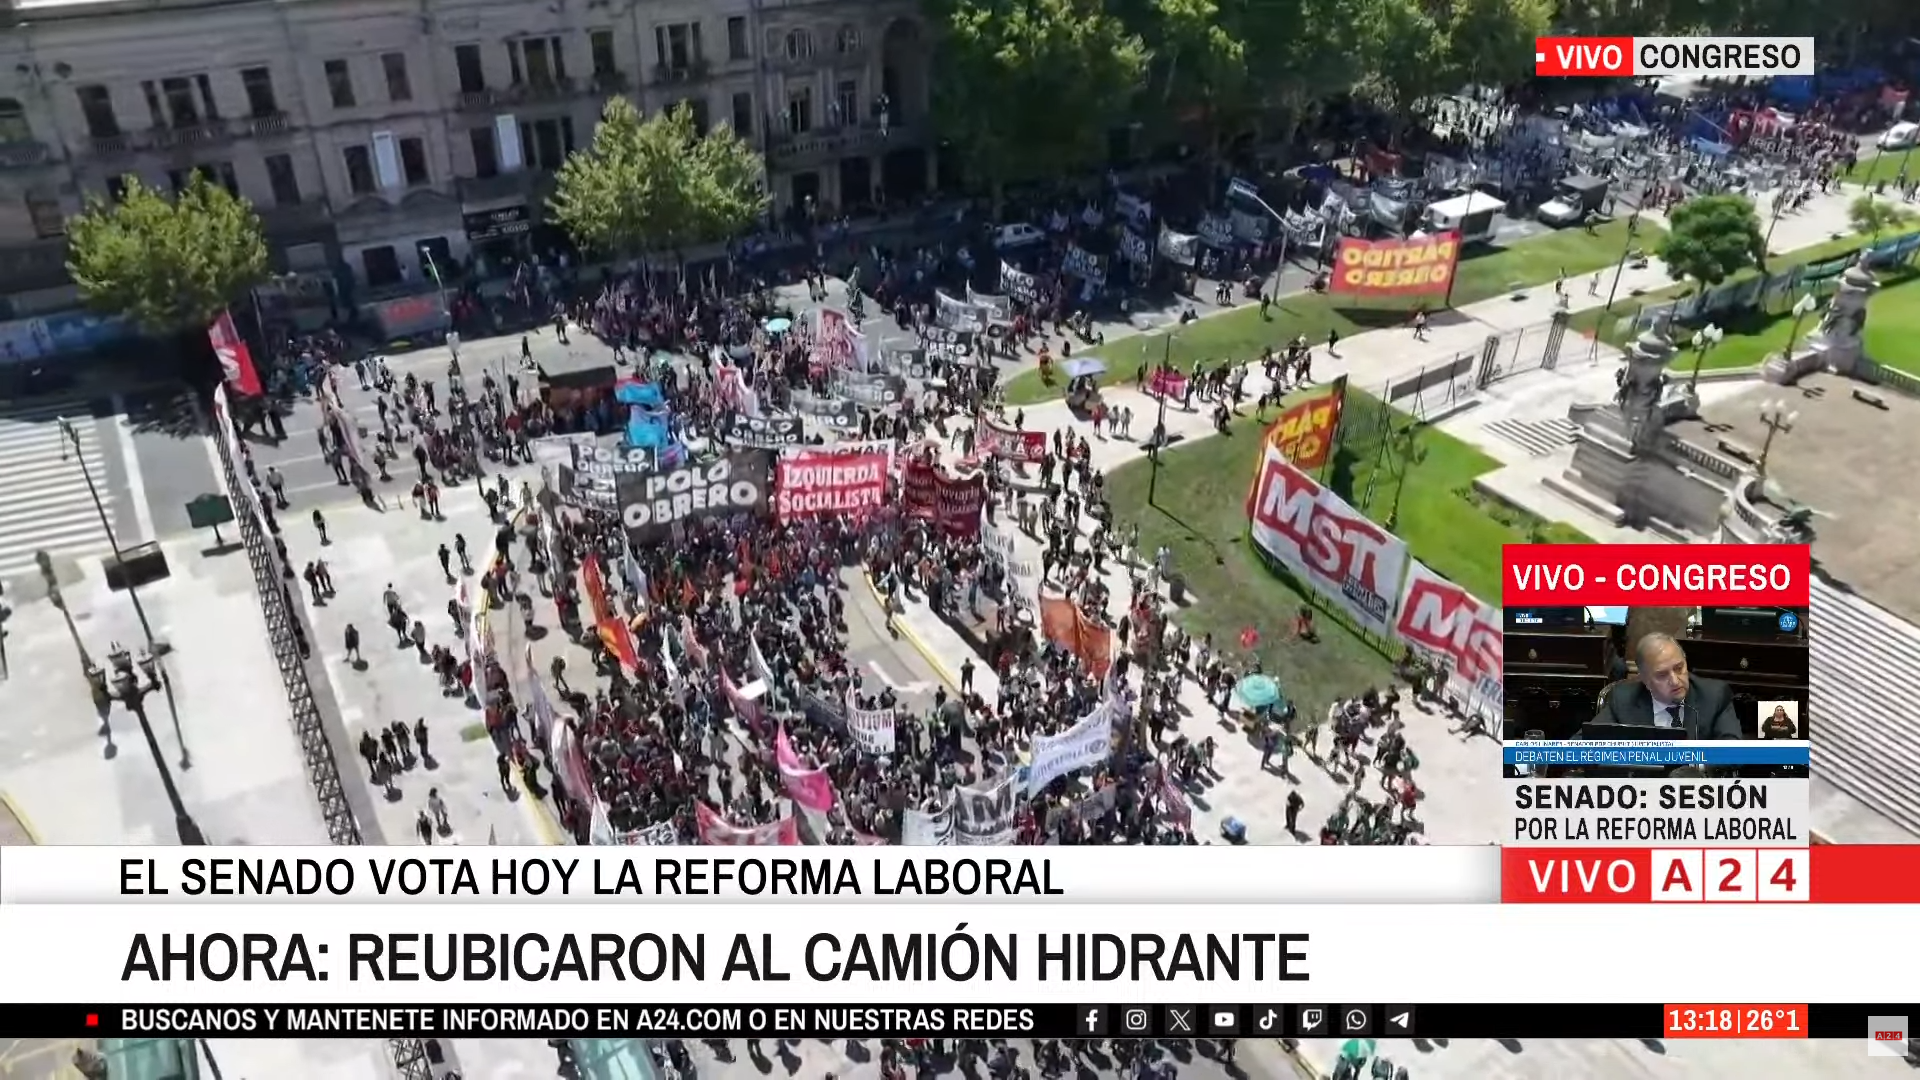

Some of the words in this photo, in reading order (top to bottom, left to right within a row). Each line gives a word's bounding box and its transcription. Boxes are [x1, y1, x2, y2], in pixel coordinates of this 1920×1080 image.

[735, 413, 793, 433] POLO
[578, 446, 646, 463] POLO
[646, 459, 730, 499] POLO
[782, 462, 879, 491] IZQUIERDA
[623, 480, 758, 528] OBRERO
[779, 486, 881, 514] SOCIALISTA
[1263, 471, 1379, 583] MST
[1410, 591, 1503, 682] MS
